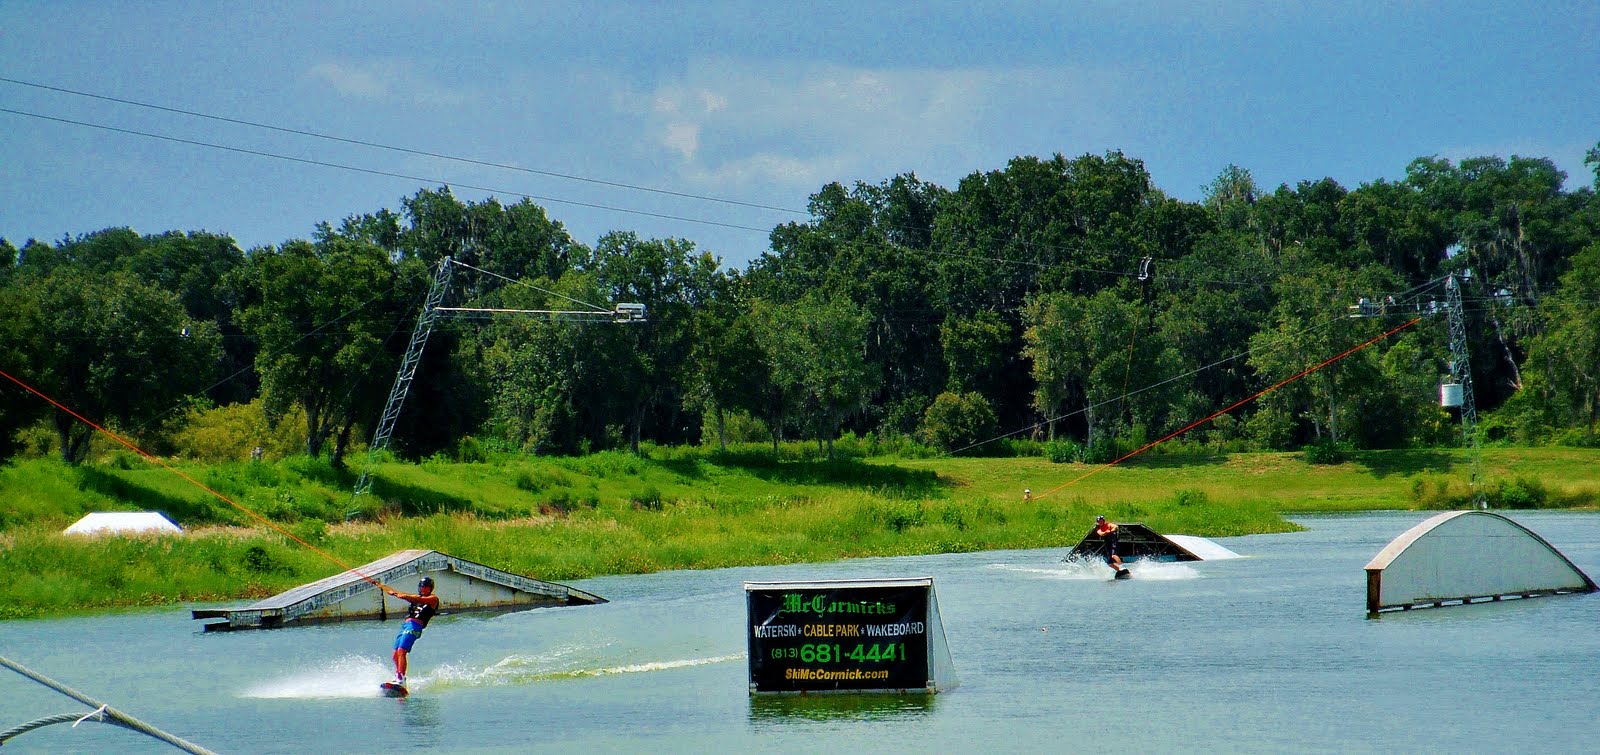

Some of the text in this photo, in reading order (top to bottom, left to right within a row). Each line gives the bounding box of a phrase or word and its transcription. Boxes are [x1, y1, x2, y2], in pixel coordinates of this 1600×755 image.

[778, 593, 896, 618] McCormicks
[754, 621, 924, 638] WATERSKI CABLE PARK WAKEBOARD
[771, 642, 906, 663] (813) 681-4441
[785, 668, 889, 680] SkiMcCormick.com
